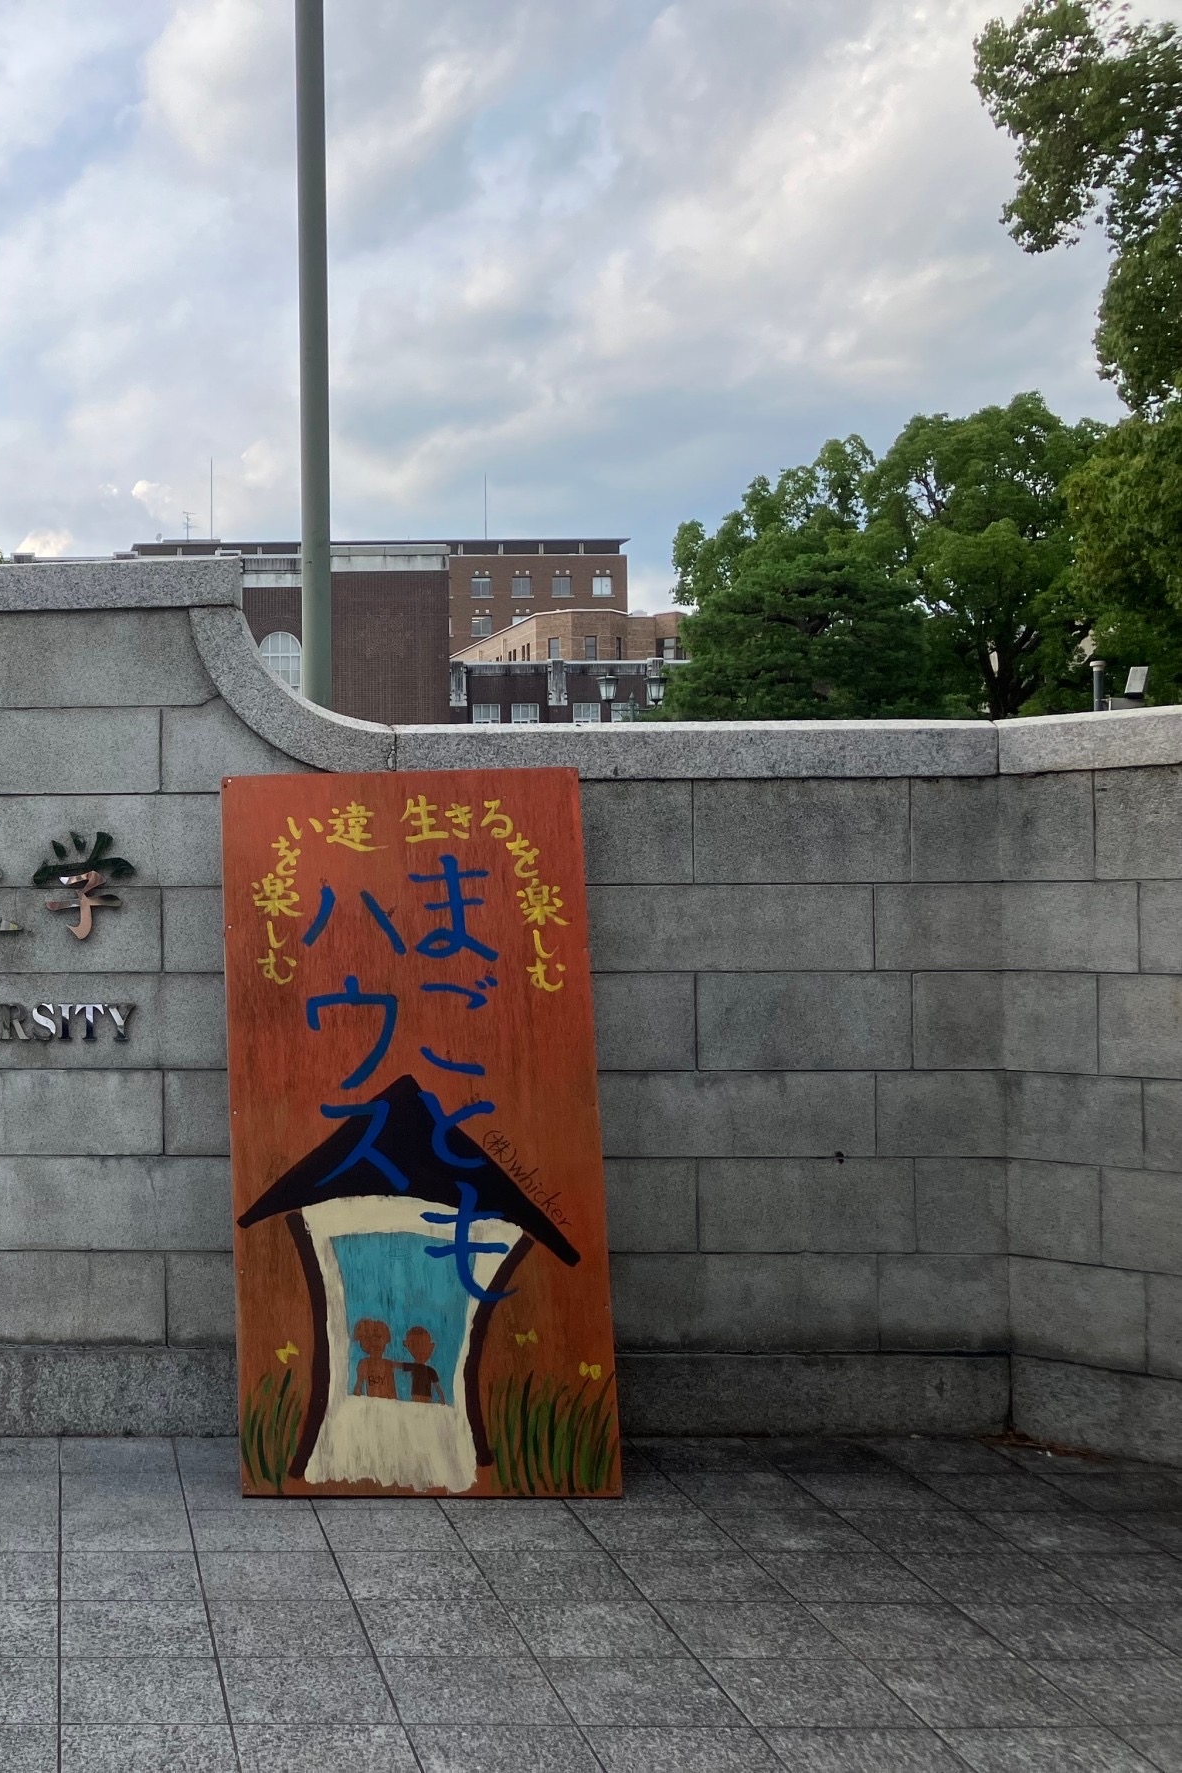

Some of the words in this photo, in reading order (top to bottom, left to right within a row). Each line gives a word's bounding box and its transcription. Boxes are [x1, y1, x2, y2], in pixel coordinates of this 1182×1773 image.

[301, 885, 411, 1192] ハウス
[399, 794, 570, 992] 生きるを楽しむ
[407, 854, 519, 1303] まごとも
